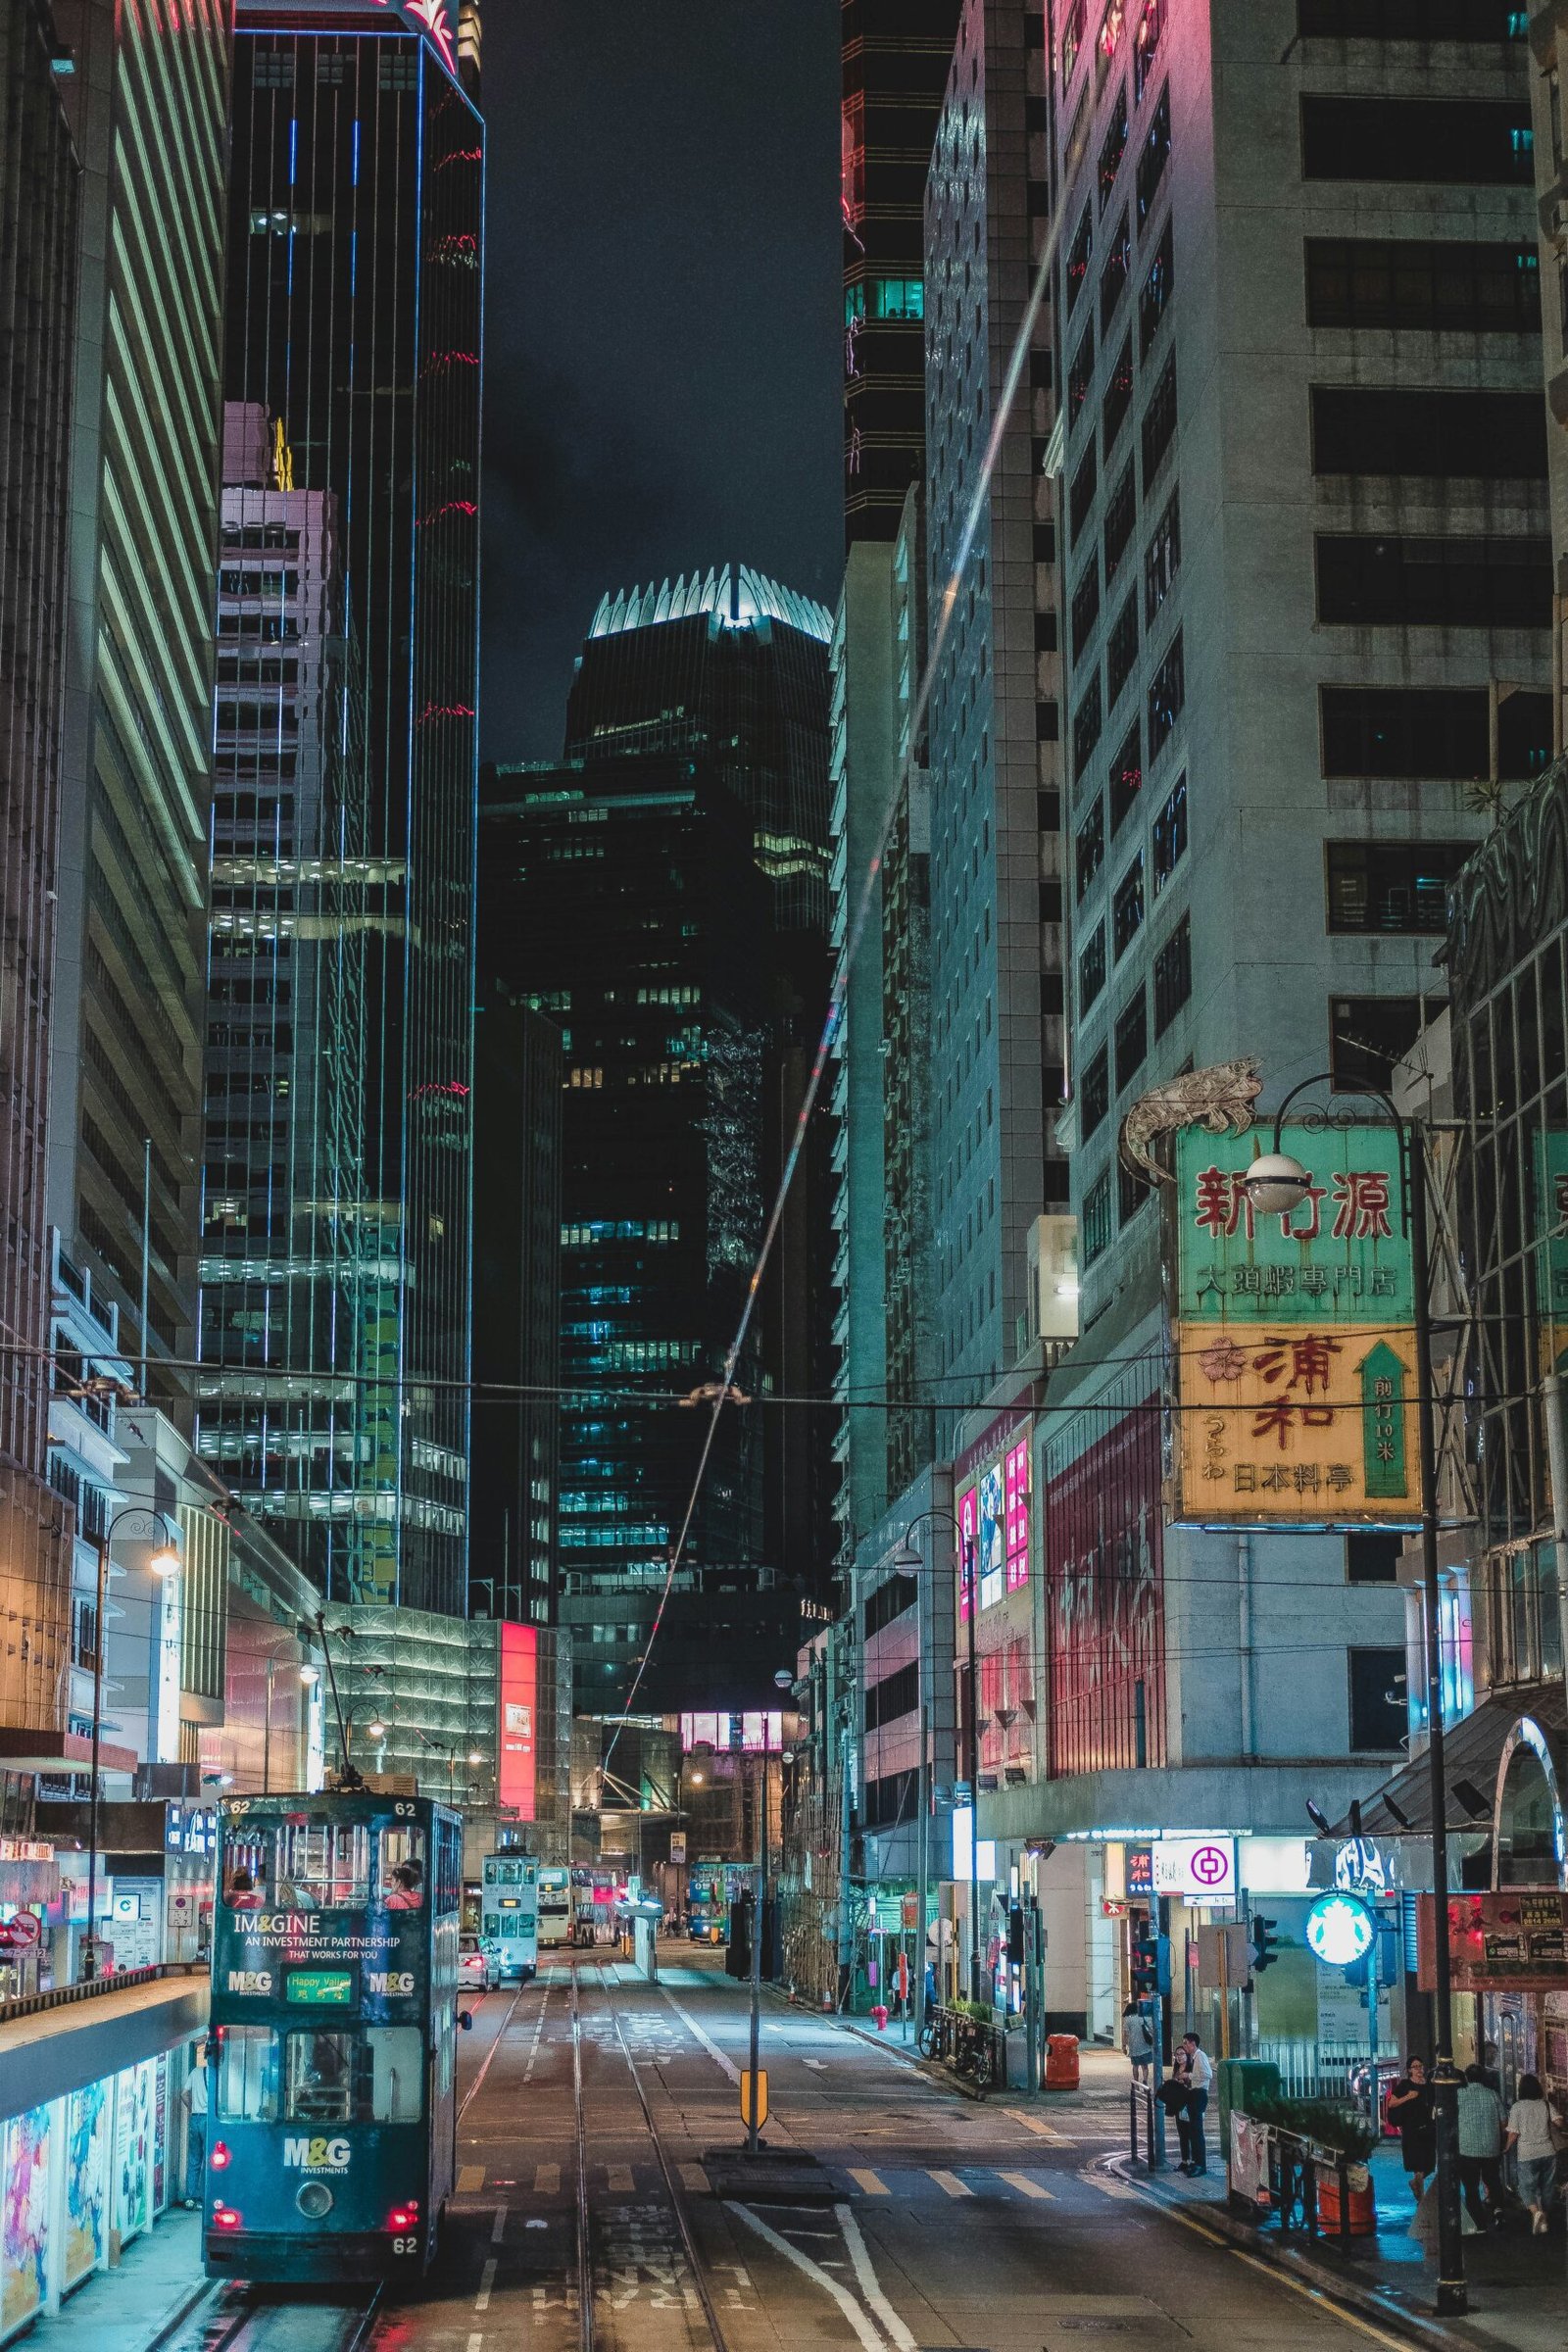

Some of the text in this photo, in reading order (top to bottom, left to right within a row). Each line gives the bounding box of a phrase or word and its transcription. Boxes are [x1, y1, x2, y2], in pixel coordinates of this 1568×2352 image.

[1196, 1263, 1396, 1297] 大頭蝦專門店
[1251, 1333, 1344, 1450] 浦和
[1202, 1416, 1225, 1480] うらわ
[1234, 1463, 1354, 1493] 日本料亭
[229, 1800, 251, 1814] 62
[395, 1802, 416, 1817] 62
[234, 1915, 320, 1934] IM&GINE
[245, 1936, 401, 1947] AN INVESTMENT PARTNERSHIP
[289, 1950, 378, 1960] THAT WORKS FOR YOU
[228, 1971, 272, 1991] M&G
[292, 1976, 320, 1987] Happy
[369, 1972, 415, 1992] M&G
[283, 2137, 351, 2167] M&G
[393, 2236, 417, 2254] 62
